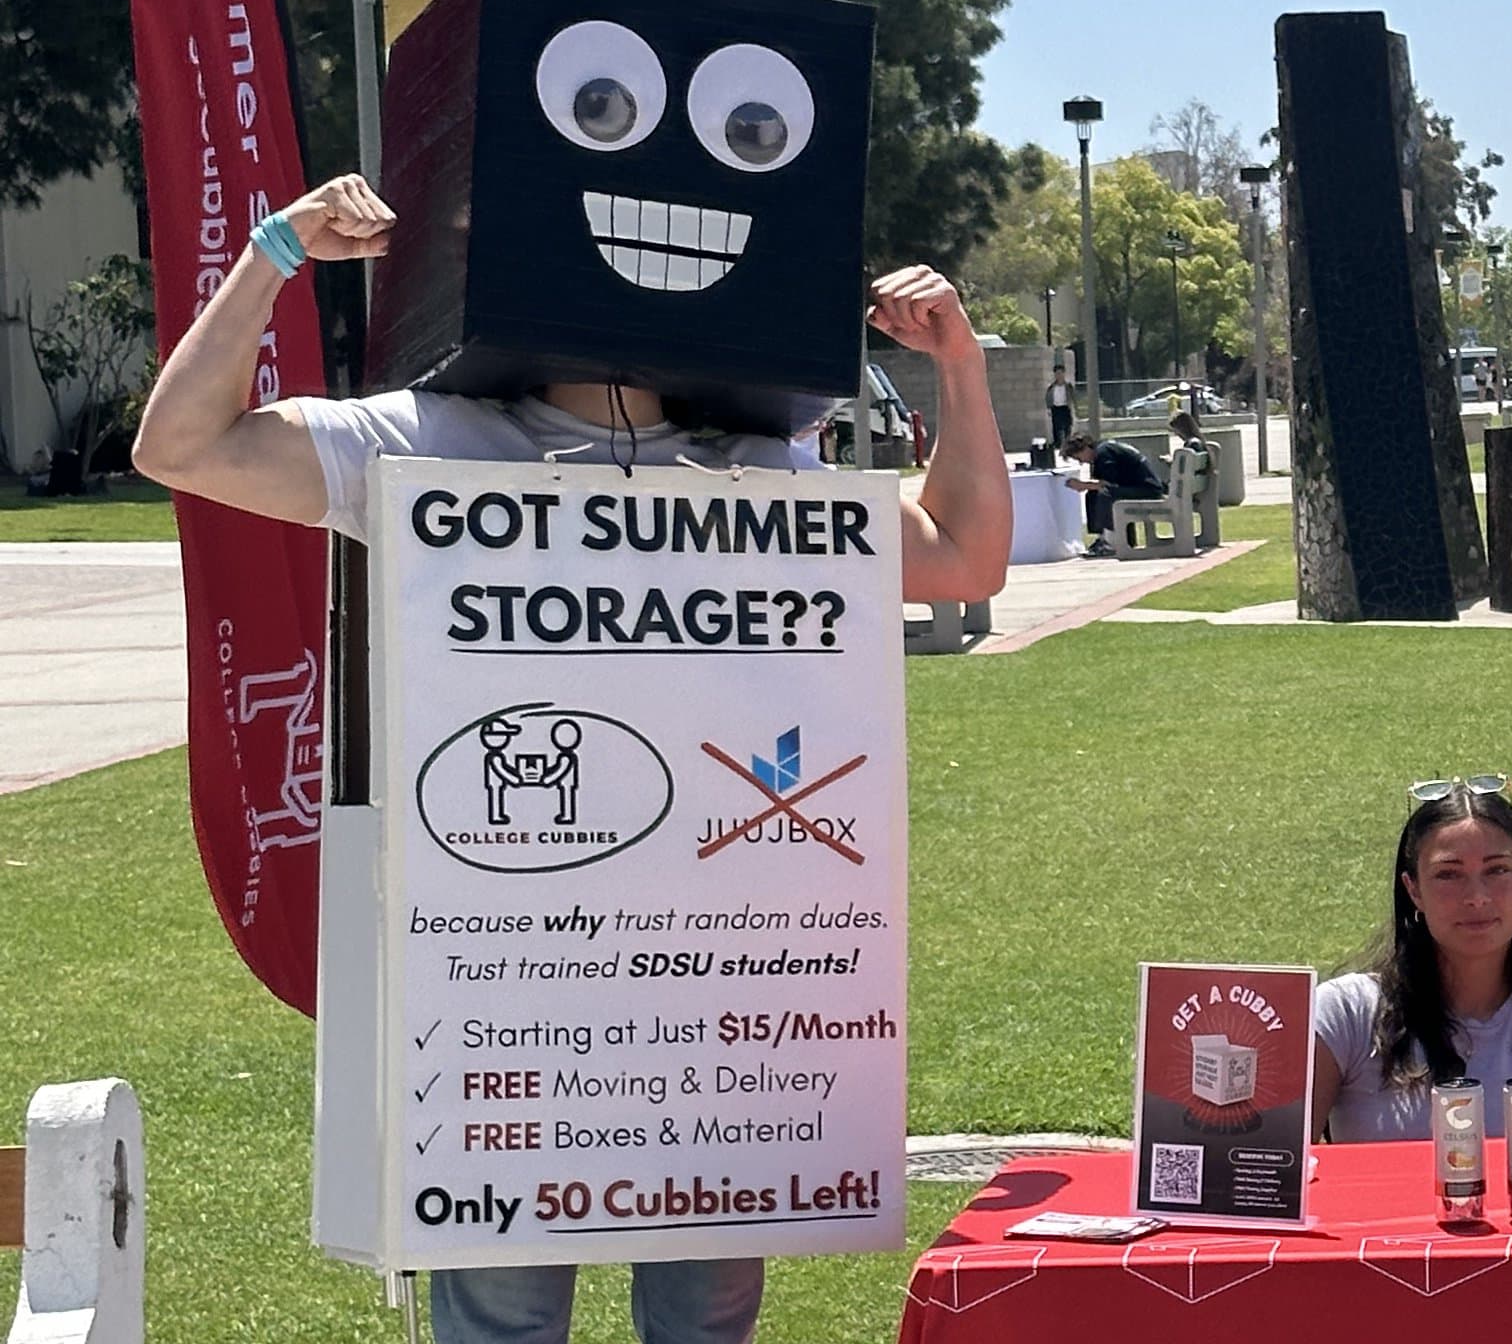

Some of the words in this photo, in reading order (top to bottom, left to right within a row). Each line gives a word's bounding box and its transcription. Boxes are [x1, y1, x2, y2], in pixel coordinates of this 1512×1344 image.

[412, 490, 560, 549] GOT
[581, 495, 876, 555] SUMMER
[447, 584, 846, 647] STORAGE??
[446, 832, 531, 844] COLLEGE
[538, 832, 618, 844] CUBBIES
[410, 907, 533, 935] because
[543, 906, 606, 939] why
[615, 908, 675, 931] trust
[684, 902, 790, 931] random
[800, 902, 889, 930] dudes.
[447, 956, 507, 982] Trust
[519, 952, 619, 980] trained
[628, 953, 713, 978] SDSU
[719, 948, 860, 976] students!
[1172, 994, 1202, 1031] GET
[1209, 985, 1223, 1005] A
[1229, 985, 1284, 1031] CUBBY
[463, 1019, 592, 1054] Starting
[605, 1020, 637, 1047] at
[648, 1016, 708, 1046] Just
[718, 1009, 897, 1049] $15/Month
[464, 1071, 541, 1100] FREE
[553, 1069, 667, 1104] Moving
[680, 1067, 703, 1095] &
[716, 1063, 838, 1099] Delivery
[464, 1122, 541, 1152] FREE
[554, 1120, 646, 1149] Boxes
[659, 1118, 681, 1146] &
[693, 1112, 823, 1144] Material
[415, 1184, 521, 1233] Only
[535, 1182, 592, 1221] 50
[603, 1177, 778, 1218] Cubbies
[790, 1170, 881, 1211] Left!
